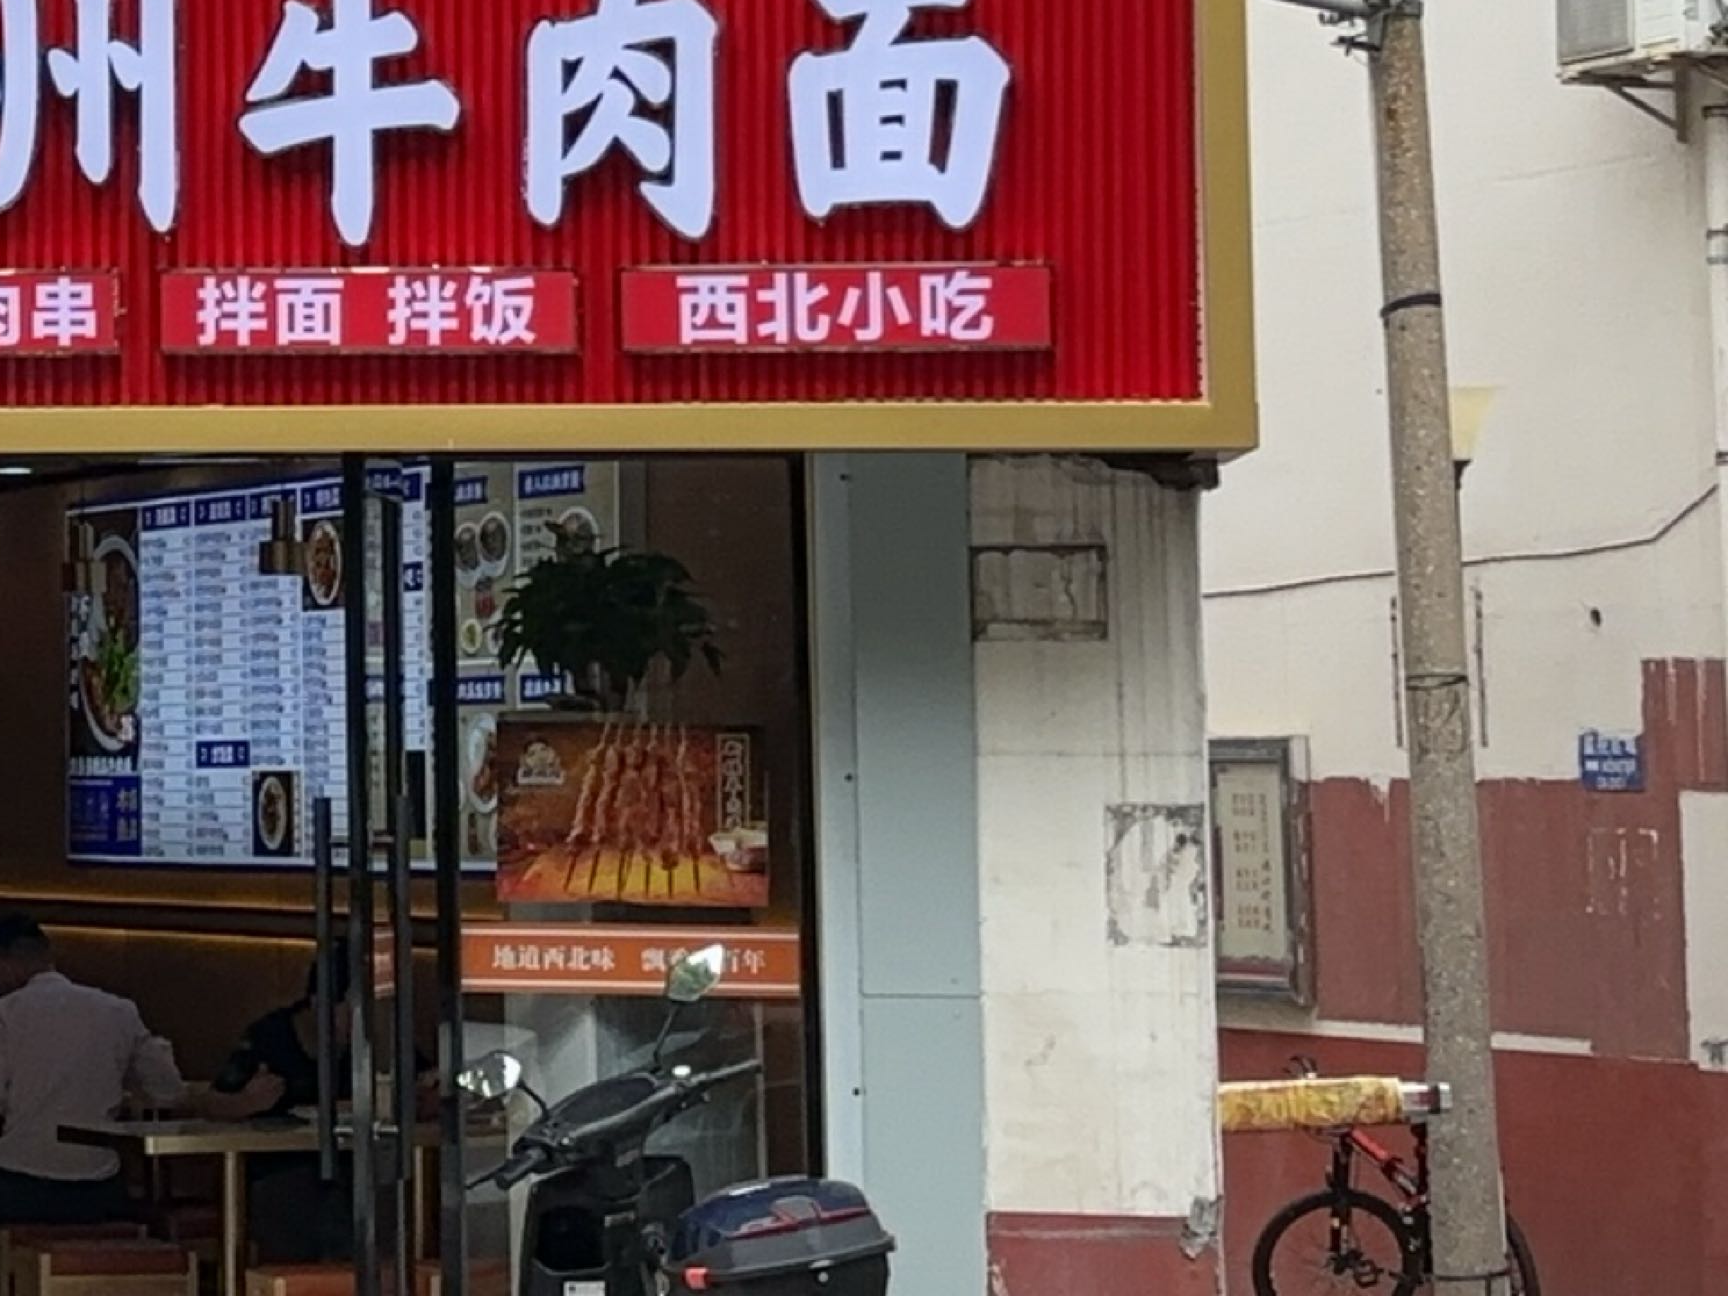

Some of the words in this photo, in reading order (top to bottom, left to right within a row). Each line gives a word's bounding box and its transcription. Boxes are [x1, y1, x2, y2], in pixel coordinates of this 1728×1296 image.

[196, 275, 345, 347] 拌面
[386, 275, 538, 346] 拌饭
[675, 270, 995, 345] 西北小吃
[491, 944, 616, 972] 地道西北味
